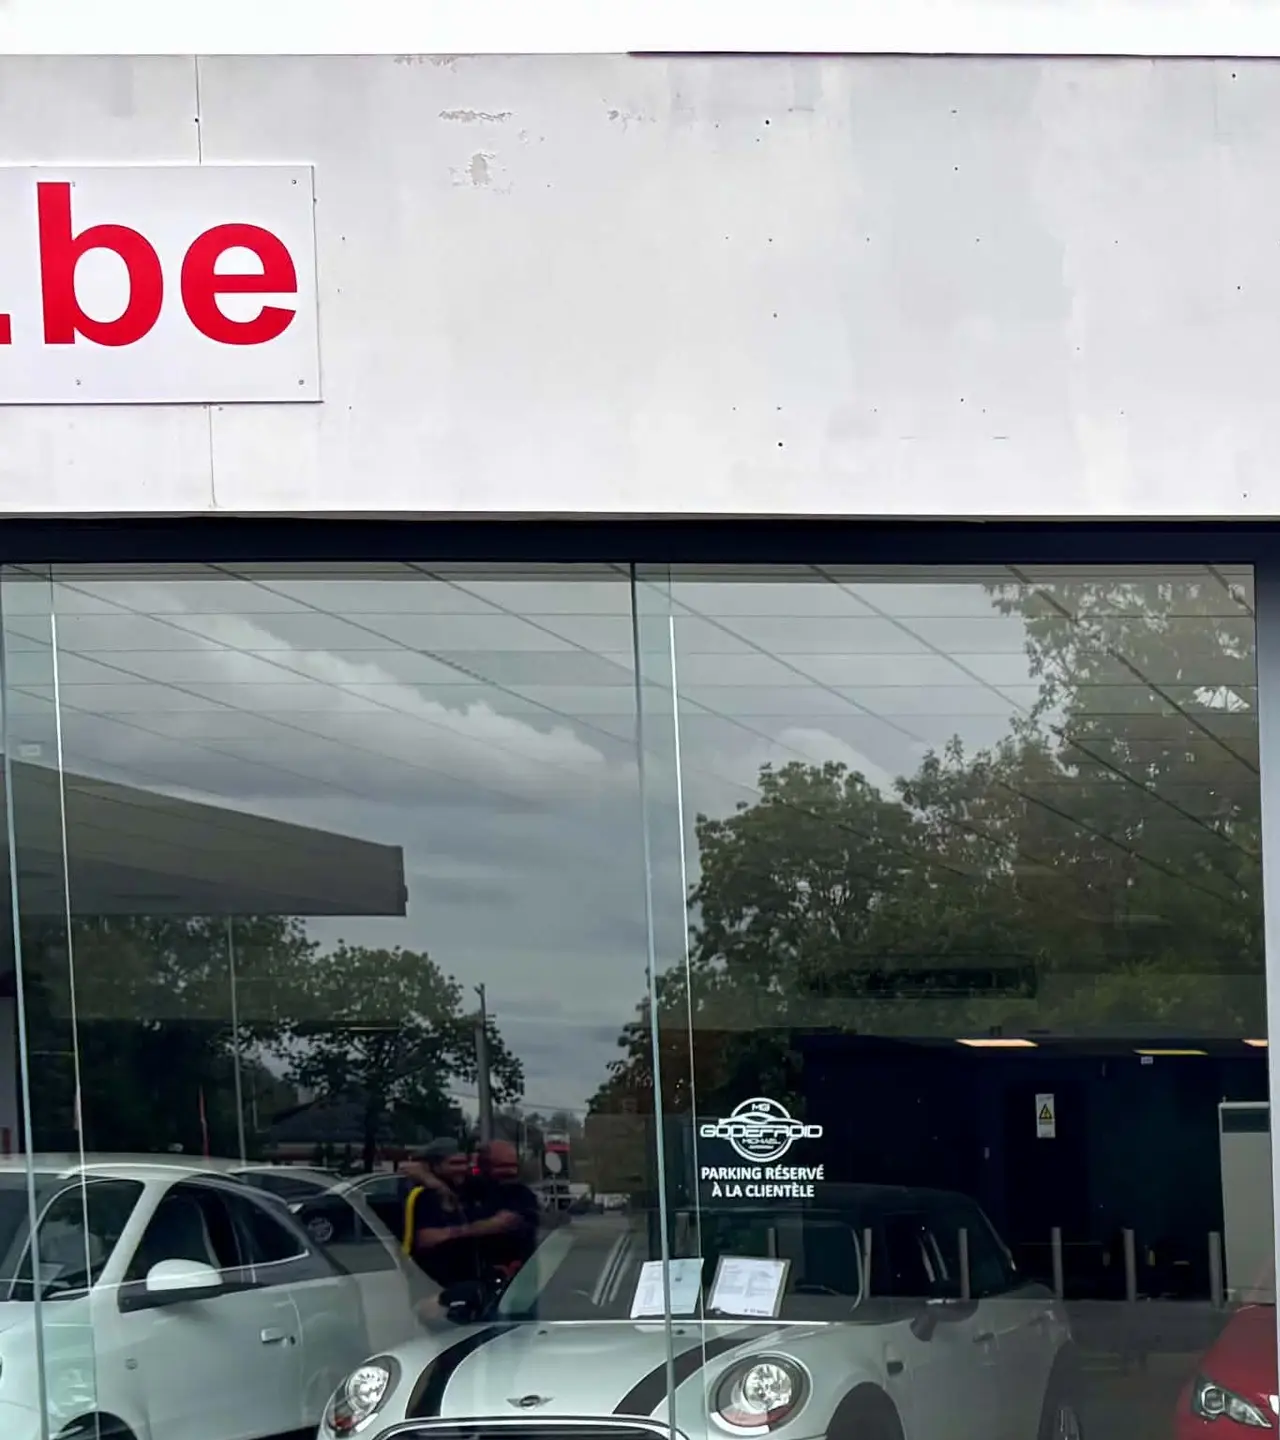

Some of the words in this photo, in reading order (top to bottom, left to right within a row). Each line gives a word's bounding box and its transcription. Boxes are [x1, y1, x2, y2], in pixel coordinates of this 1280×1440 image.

[700, 1124, 823, 1139] GODEFROID
[701, 1166, 762, 1180] PARKING
[765, 1163, 825, 1180] RÉSERVÉ
[712, 1181, 722, 1197] À
[725, 1184, 743, 1198] LA
[745, 1181, 815, 1198] CLIENTÈLE
